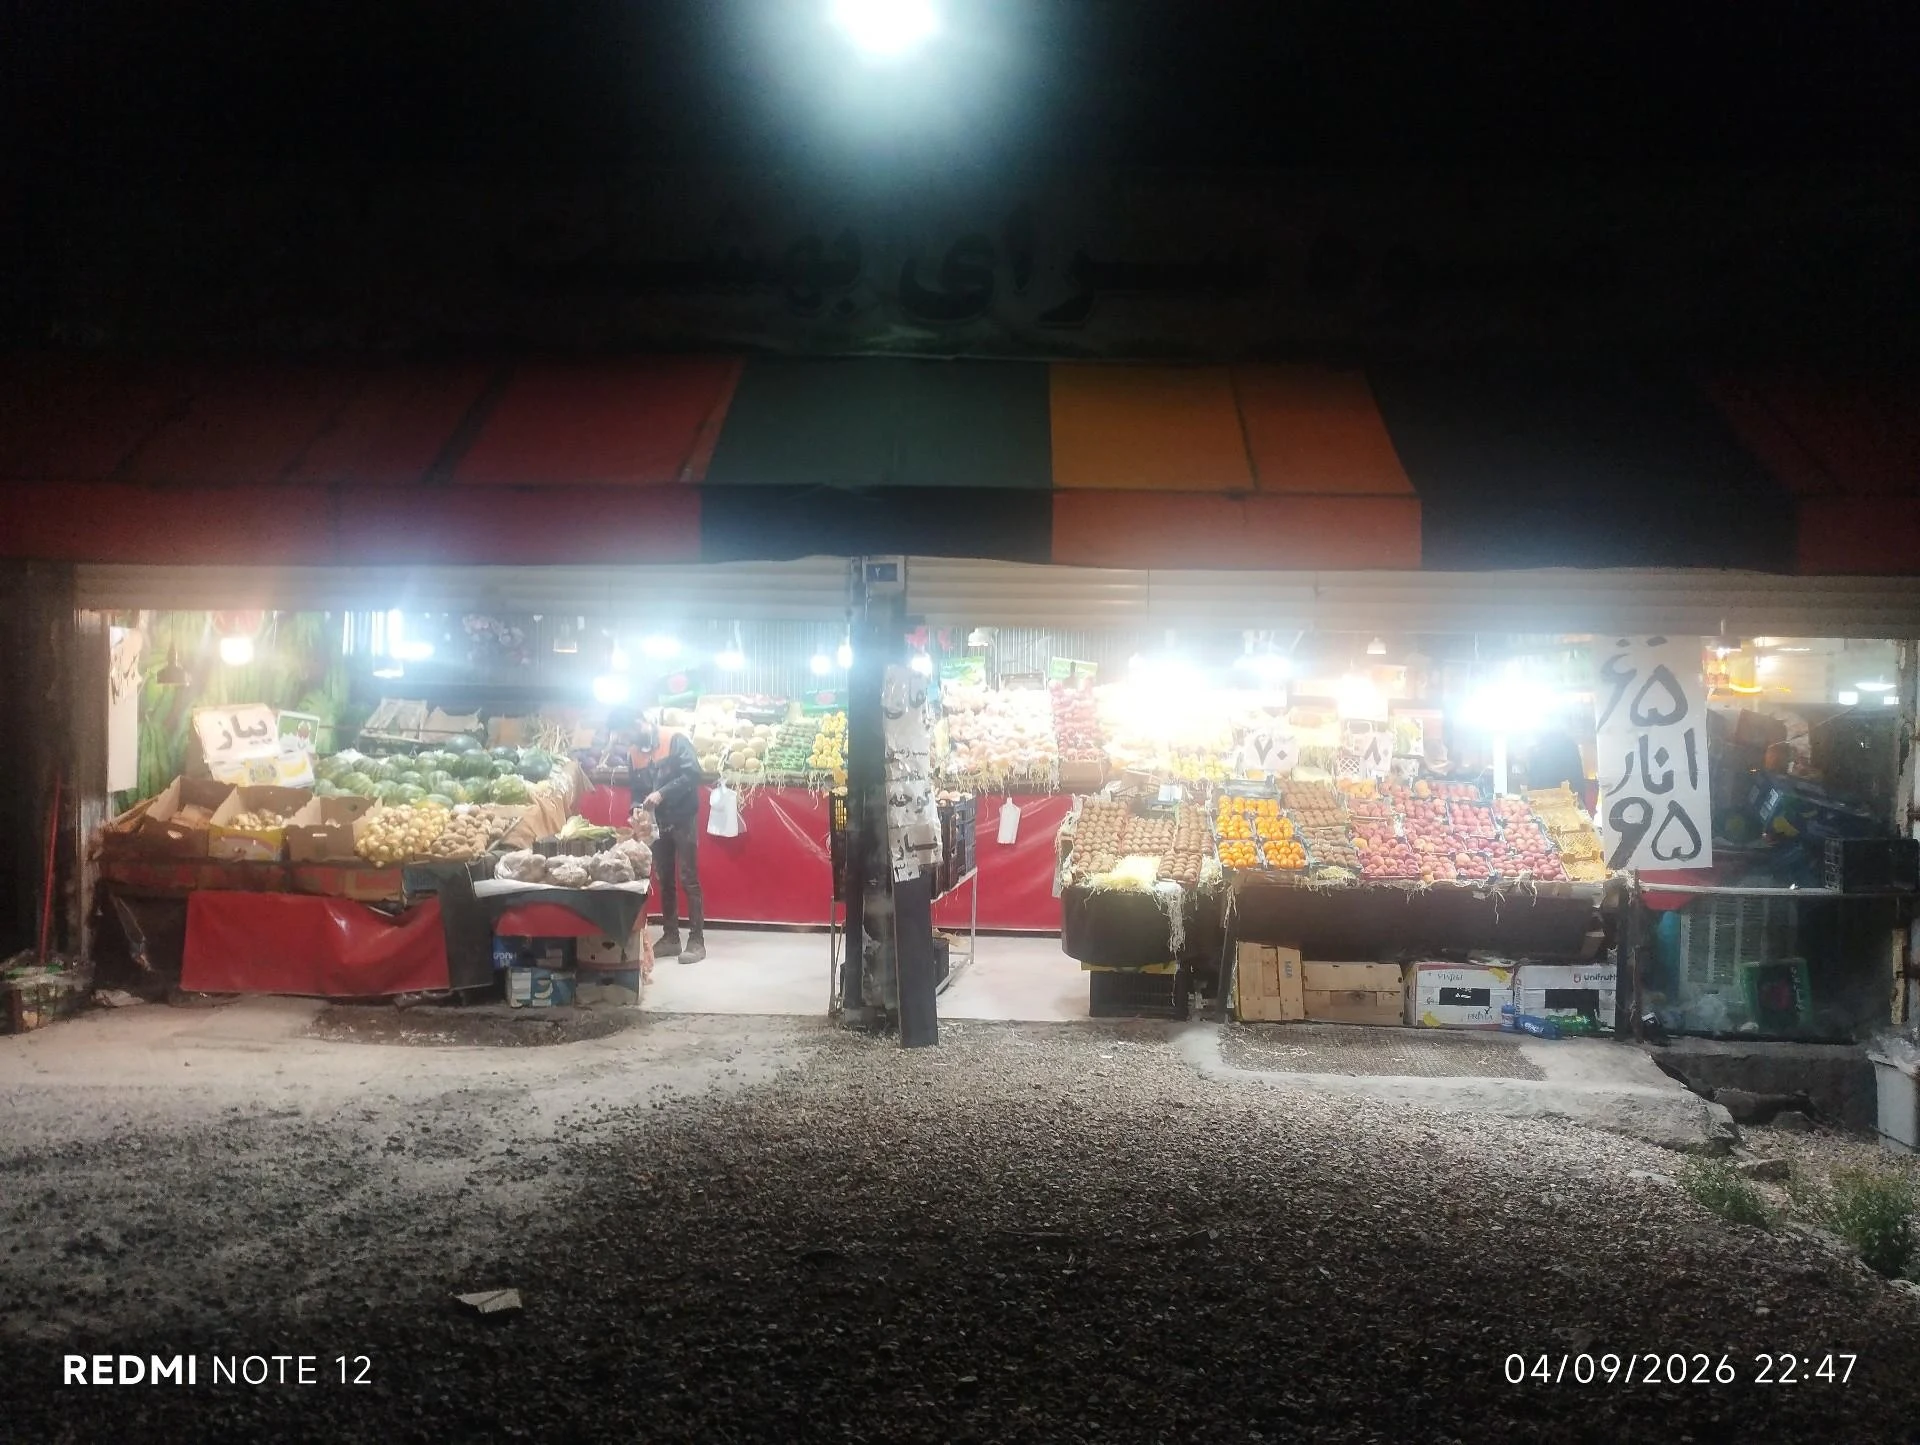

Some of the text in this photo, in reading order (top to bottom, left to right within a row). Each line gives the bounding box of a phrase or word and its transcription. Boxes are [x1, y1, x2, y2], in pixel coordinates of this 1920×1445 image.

[216, 714, 273, 751] پیاز
[1605, 727, 1698, 797] انار
[1605, 796, 1702, 870] ۹۵
